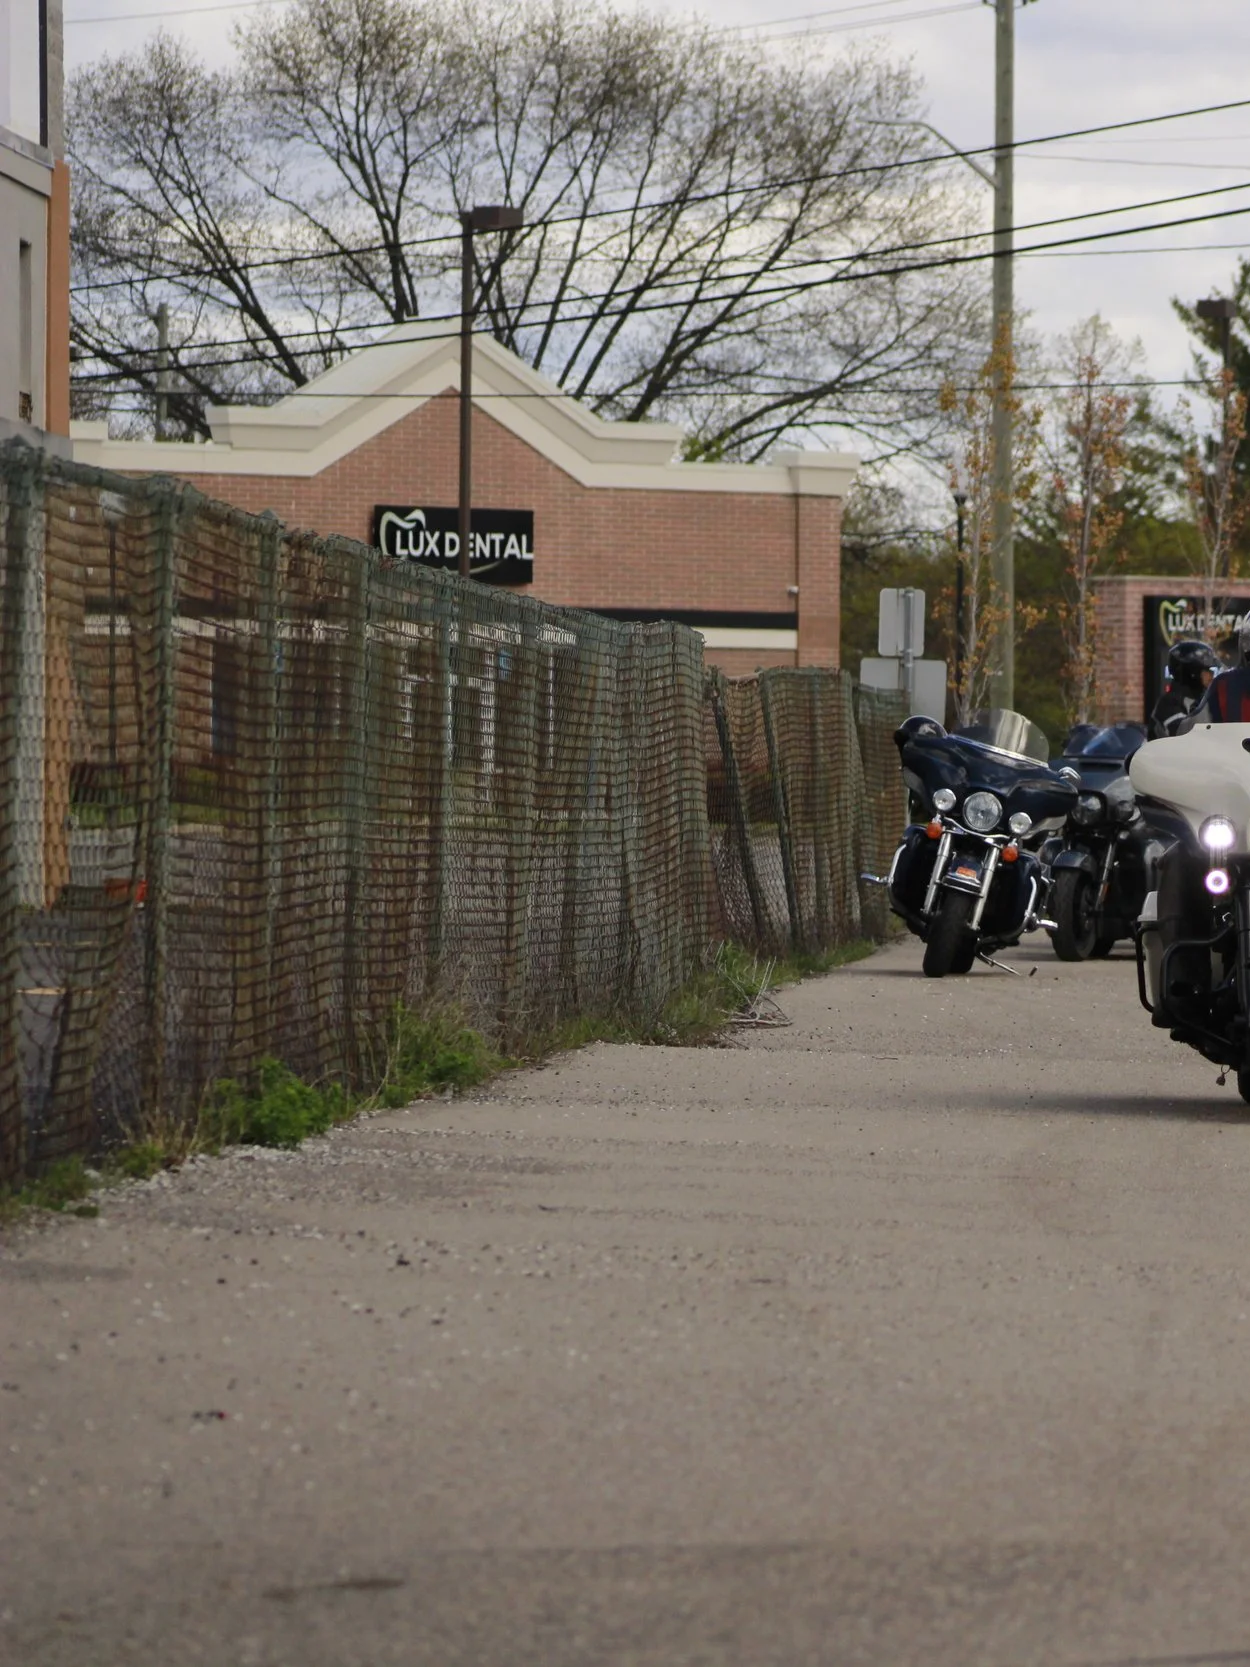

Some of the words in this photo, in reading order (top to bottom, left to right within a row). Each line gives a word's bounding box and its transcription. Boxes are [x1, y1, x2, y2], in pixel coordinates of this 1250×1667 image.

[395, 530, 440, 557] LUX
[1167, 613, 1196, 632] LUX
[1197, 614, 1246, 632] DNTA
